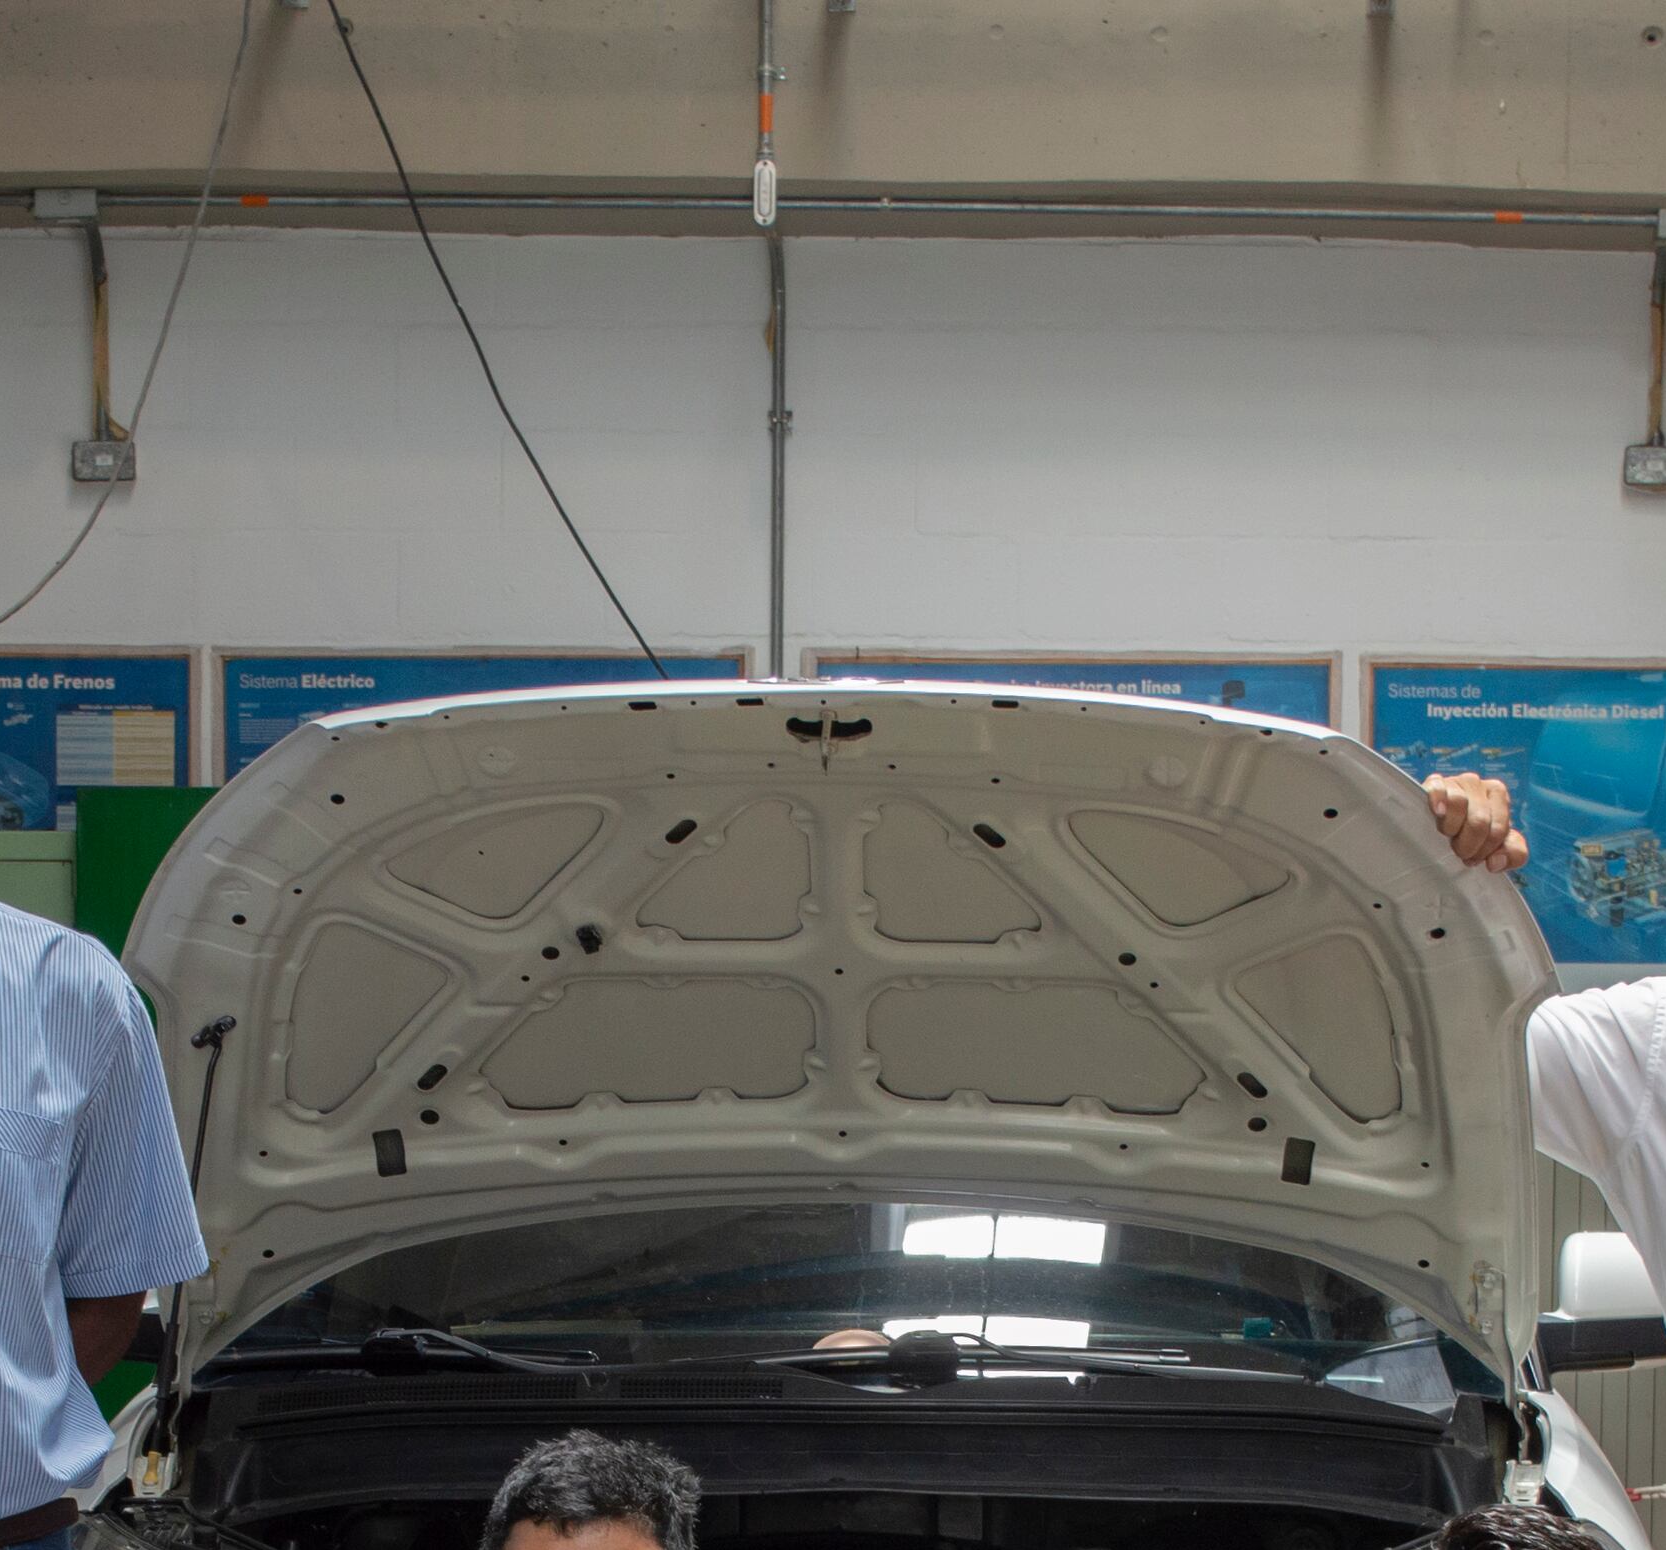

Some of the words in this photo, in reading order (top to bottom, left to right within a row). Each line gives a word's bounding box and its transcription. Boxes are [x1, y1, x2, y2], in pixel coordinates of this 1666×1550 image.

[28, 674, 49, 689] de
[54, 674, 116, 690] Frenos
[239, 673, 298, 689] Sistema
[300, 672, 376, 689] Eléctrico
[1117, 682, 1138, 695] en
[1141, 680, 1182, 695] línea
[1388, 683, 1458, 699] Sistemas
[1460, 683, 1482, 699] de
[1427, 702, 1508, 721] Inyección
[1511, 702, 1608, 719] Electrónica
[1612, 703, 1665, 719] Diesel
